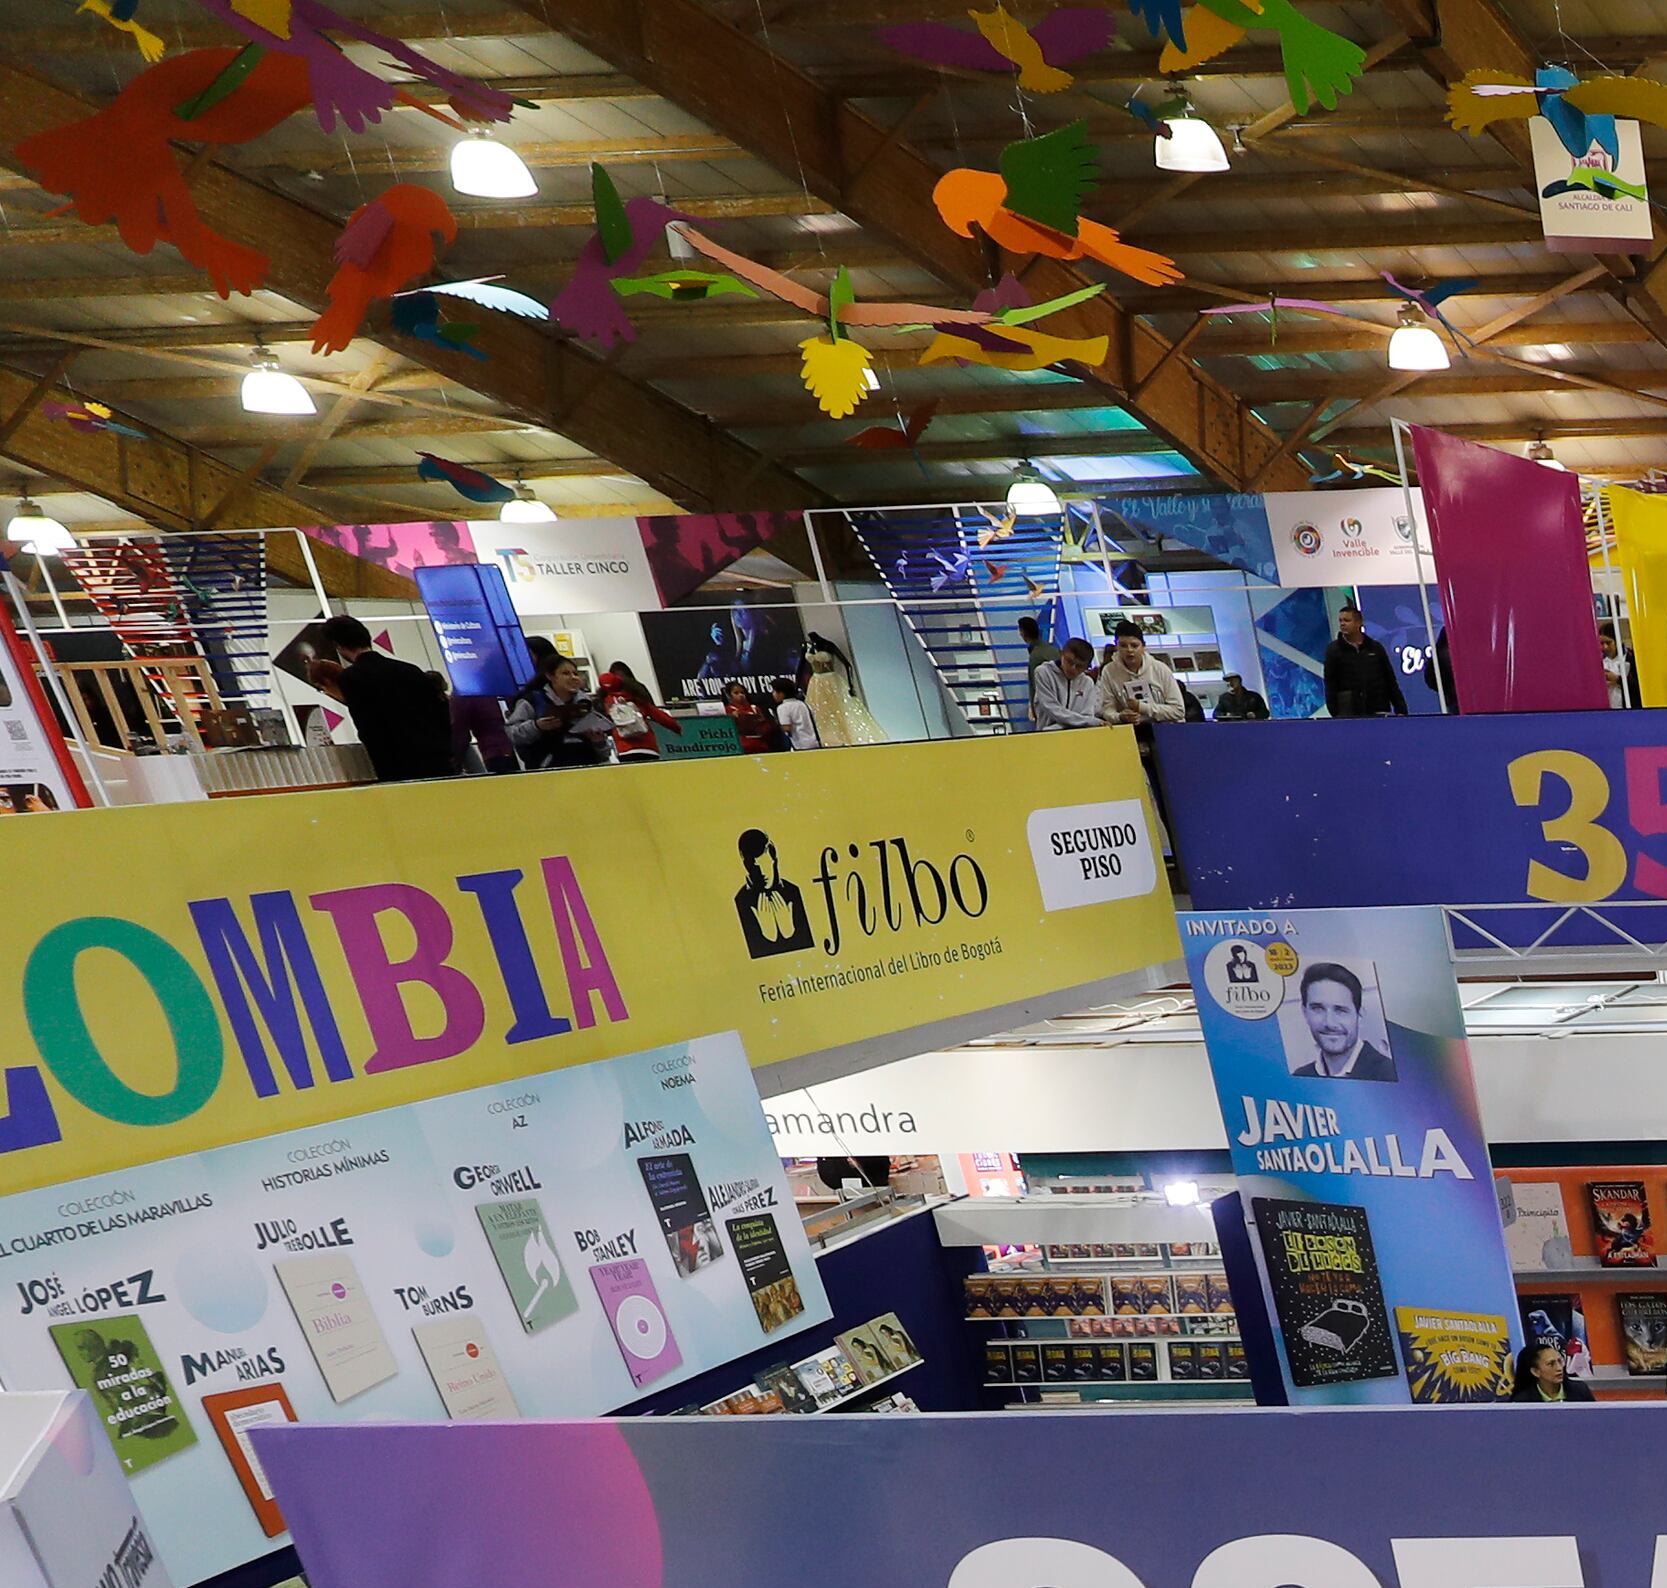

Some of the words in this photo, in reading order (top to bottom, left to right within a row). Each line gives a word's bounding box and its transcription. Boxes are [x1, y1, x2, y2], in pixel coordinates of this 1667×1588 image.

[1558, 203, 1600, 211] SANTIAGO
[1615, 204, 1632, 212] CALI
[1332, 547, 1380, 558] Invencible
[1341, 539, 1367, 549] Valle
[535, 560, 584, 577] TALLER
[587, 559, 630, 576] CINCO
[1049, 823, 1138, 857] SEGUNDO
[1079, 853, 1123, 881] PISO
[811, 837, 990, 957] filbo
[1186, 919, 1278, 936] INVITADO
[1284, 919, 1297, 935] A
[759, 978, 796, 1004] Feria
[796, 957, 886, 996] Internacional
[888, 956, 909, 976] del
[910, 948, 942, 972] Libro
[944, 945, 959, 964] de
[961, 936, 1004, 963] Bogotá
[1226, 984, 1271, 1004] filbo
[1236, 1094, 1341, 1148] JAVIER
[1257, 1126, 1476, 1182] SANTAOLALLA
[261, 1164, 333, 1193] HISTORIAS
[333, 1148, 391, 1177] MÍNIMAS
[490, 1166, 542, 1197] ORWELL
[129, 1192, 214, 1226] MARAVILLAS
[1592, 1187, 1641, 1203] SKANDAR
[253, 1217, 297, 1251] JULIO
[573, 1227, 601, 1253] BOB
[593, 1229, 640, 1263] STANLEY
[17, 1271, 66, 1315] JOSÉ
[76, 1269, 167, 1315] LÓPEZ
[422, 1285, 475, 1316] BURNS
[1414, 1314, 1443, 1330] JAVIER
[1444, 1316, 1498, 1335] SANTAOLALLA
[237, 1346, 286, 1382] ARIAS
[1440, 1352, 1461, 1366] BIG
[1462, 1350, 1490, 1369] BANG
